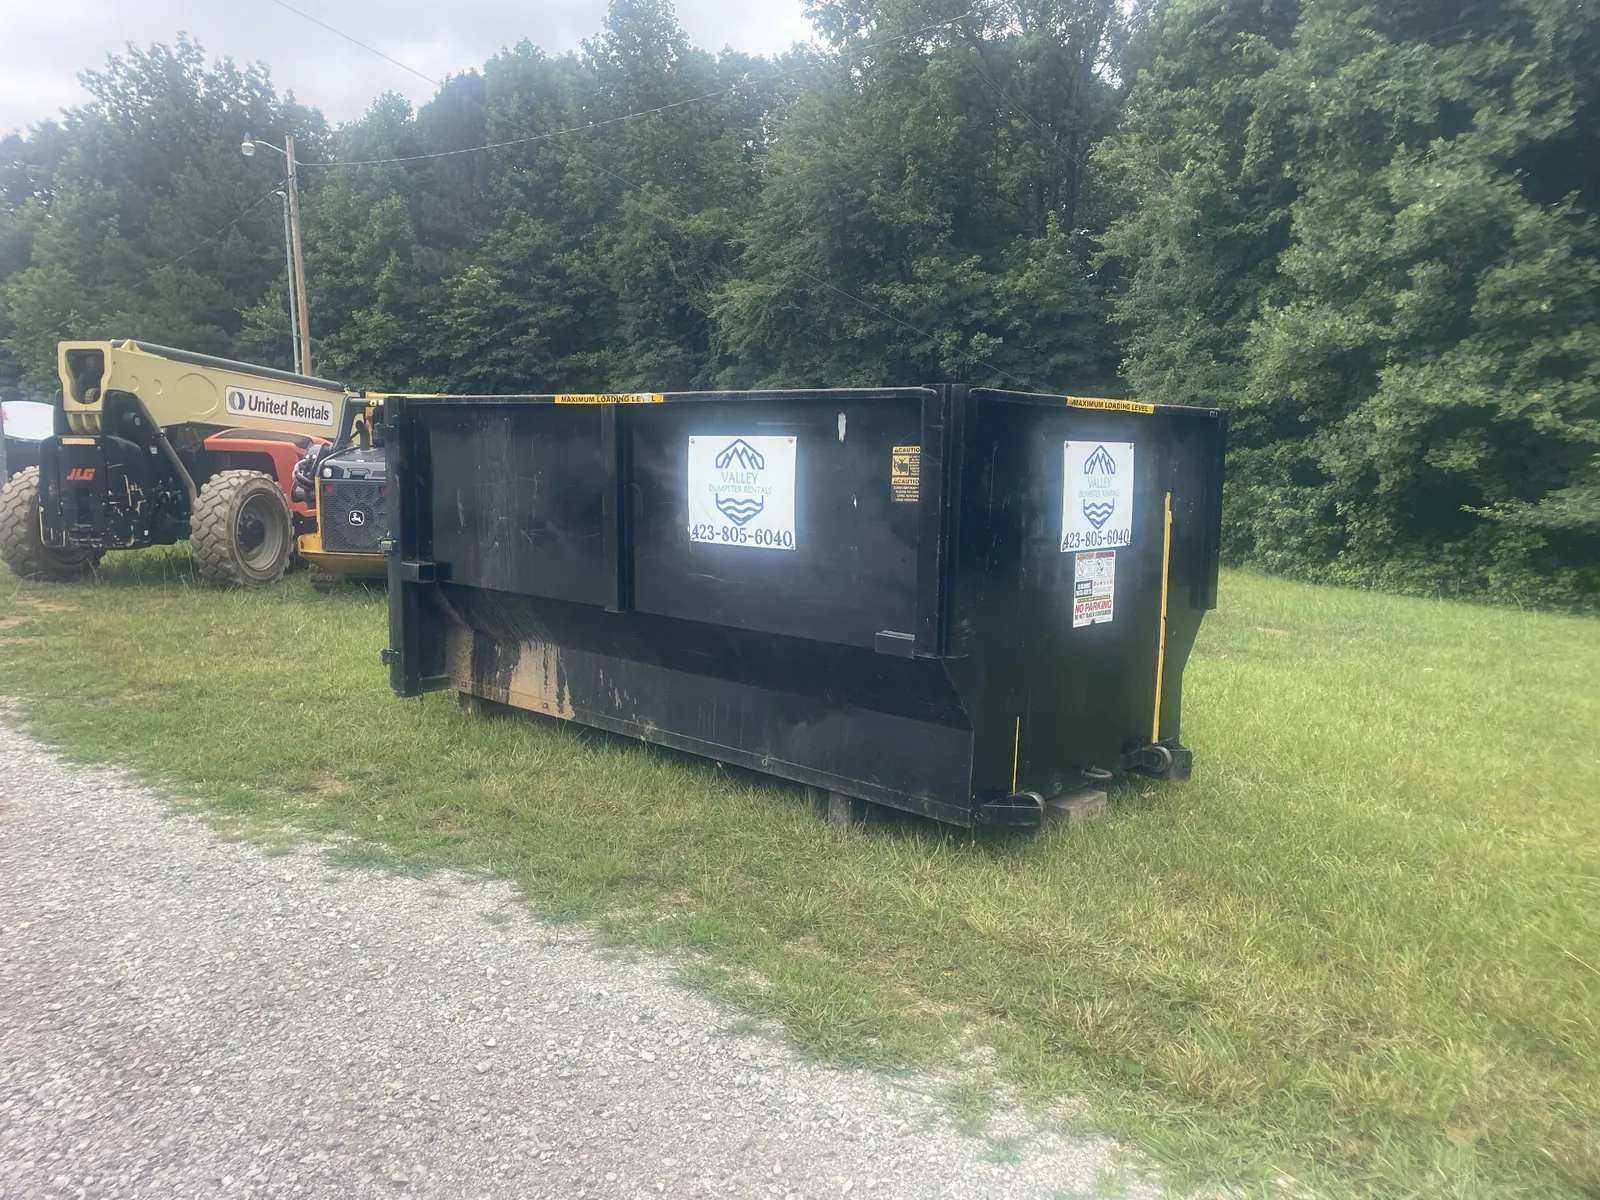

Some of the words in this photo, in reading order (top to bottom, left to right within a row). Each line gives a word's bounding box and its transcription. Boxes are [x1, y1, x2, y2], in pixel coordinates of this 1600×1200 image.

[597, 395, 630, 403] LOADING
[1071, 399, 1104, 408] MAXIMUM
[1105, 401, 1130, 411] LOADING
[1132, 403, 1149, 412] LEVEL
[248, 394, 289, 415] United
[290, 401, 330, 421] Rentals
[66, 468, 96, 481] JLG
[721, 471, 759, 484] VALLEY
[1087, 476, 1112, 489] VALLEY
[708, 484, 742, 493] DUMPSTER
[743, 485, 772, 495] RENTALS
[692, 523, 793, 547] 423-805-6040
[1063, 529, 1130, 549] 423-805-6040
[1075, 604, 1084, 614] NO
[1085, 600, 1112, 612] PARKING
